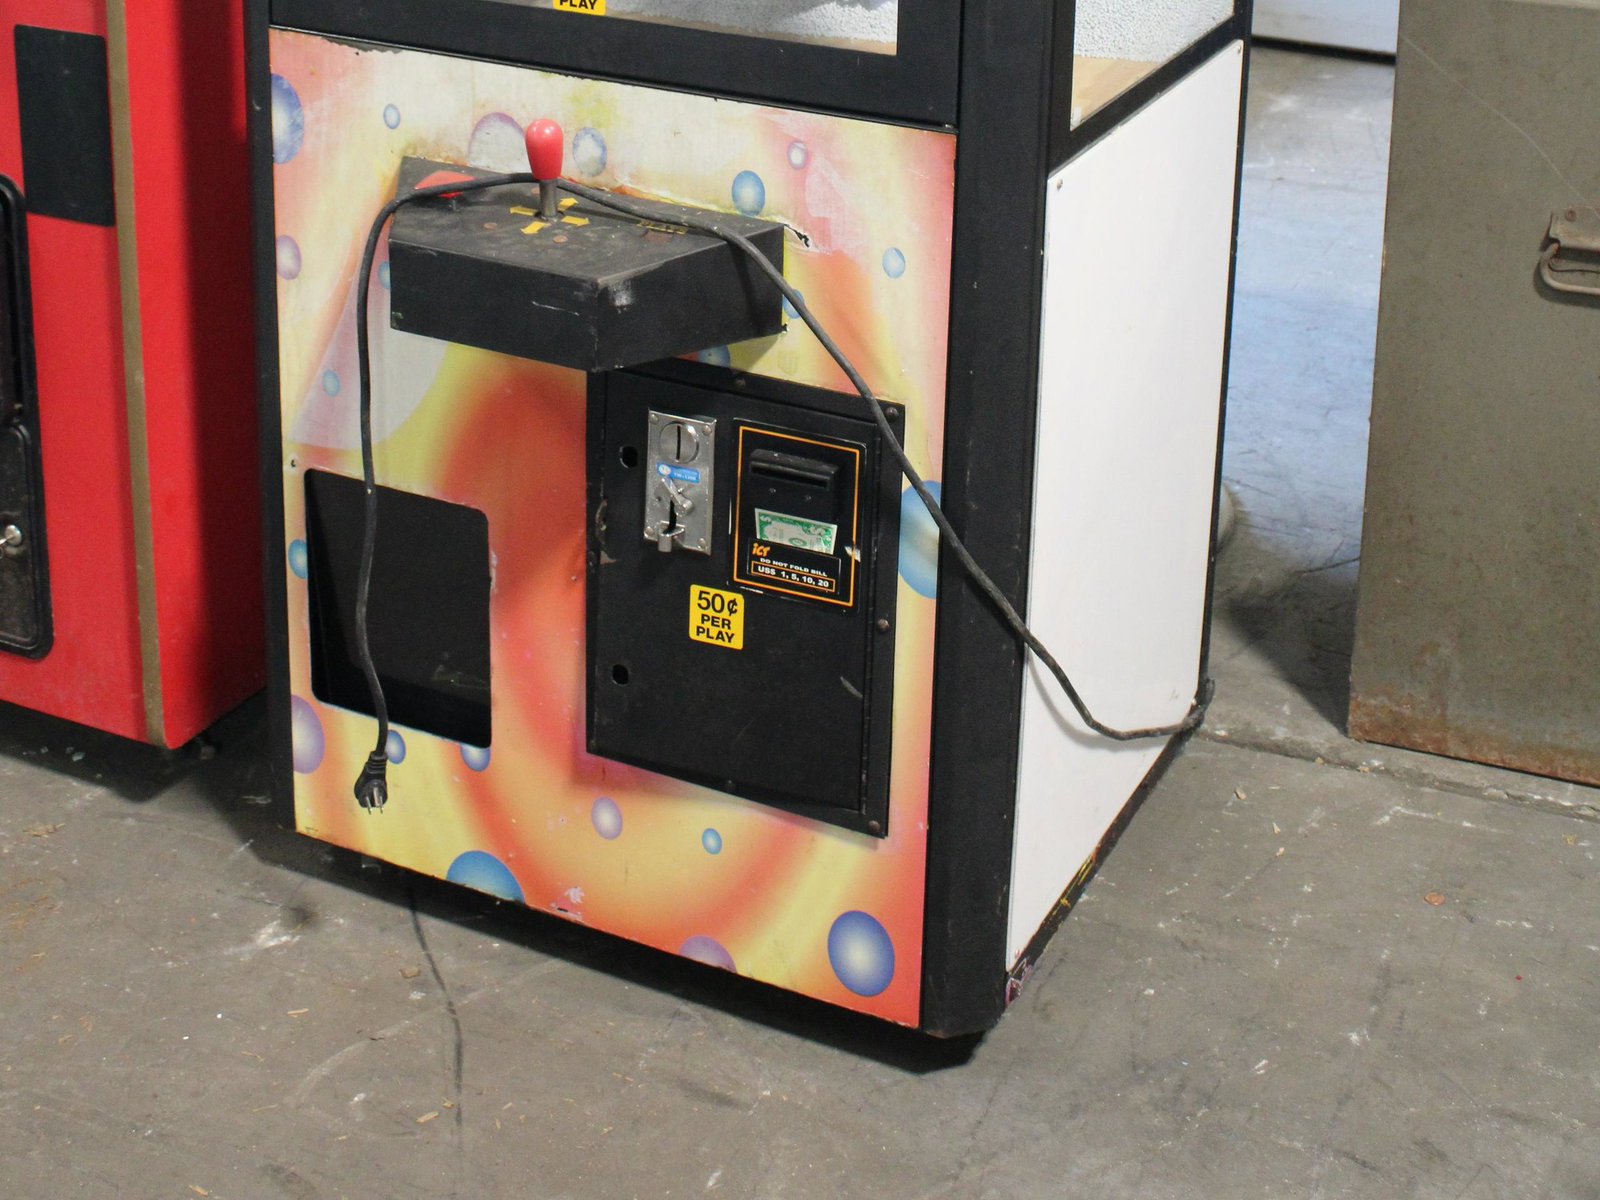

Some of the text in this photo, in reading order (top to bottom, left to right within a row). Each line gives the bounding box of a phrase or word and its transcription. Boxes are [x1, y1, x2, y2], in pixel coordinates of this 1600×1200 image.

[772, 560, 788, 568] NOT
[789, 564, 809, 572] FOLD
[810, 569, 827, 577] BILL
[780, 571, 789, 579] 1,
[791, 573, 800, 581] 5,
[802, 576, 815, 585] 10,
[818, 579, 829, 587] 20
[696, 590, 739, 617] 50¢
[700, 613, 732, 631] PER
[695, 625, 735, 645] PLAY
